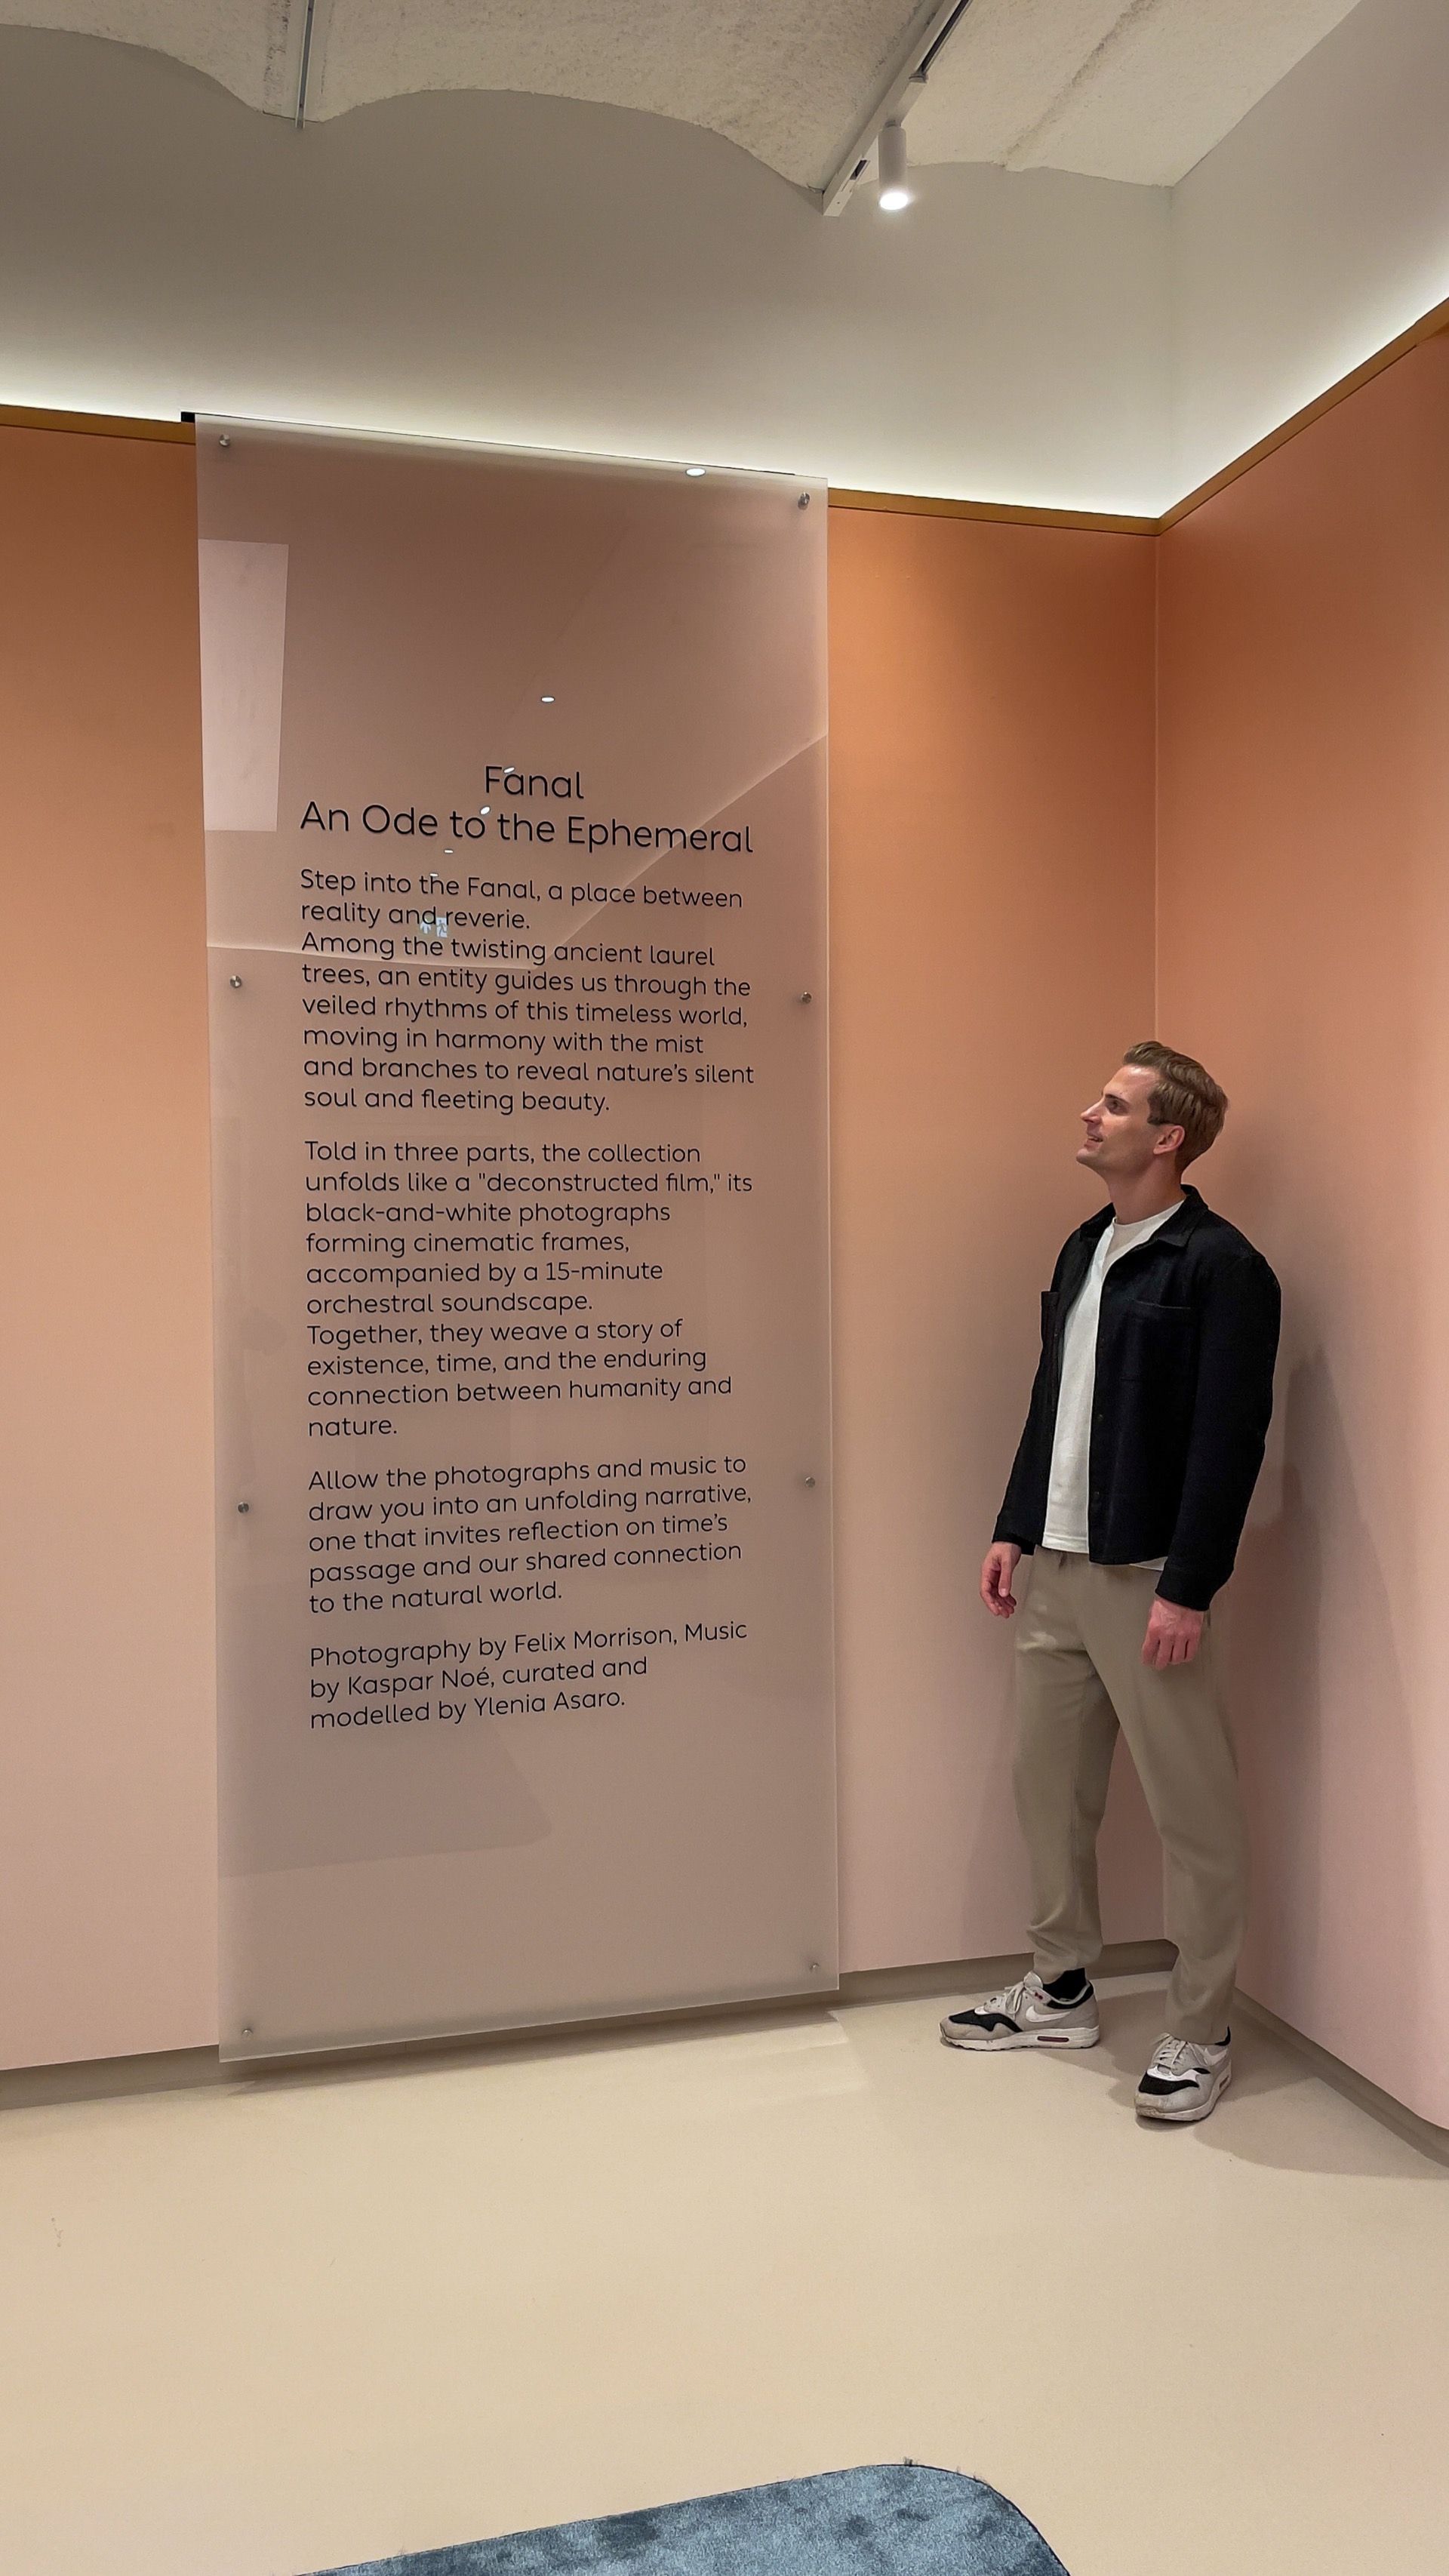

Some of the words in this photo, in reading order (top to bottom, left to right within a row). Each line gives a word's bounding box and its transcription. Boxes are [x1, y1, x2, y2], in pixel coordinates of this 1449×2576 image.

[485, 765, 585, 800] Fanal
[300, 801, 349, 833] An
[362, 804, 438, 837] Ode
[449, 808, 486, 839] to
[497, 812, 555, 843] the
[568, 816, 754, 854] Ephemeral
[300, 868, 356, 897] Step
[364, 871, 411, 894] into
[418, 872, 460, 896] the
[468, 876, 541, 902] Fanal,
[548, 885, 562, 900] a
[571, 882, 635, 907] place
[643, 885, 742, 908] between
[301, 902, 381, 929] reality
[388, 906, 437, 925] and
[445, 909, 530, 930] reverie.
[301, 931, 395, 961] Among
[401, 935, 444, 956] the
[450, 938, 546, 966] twisting
[554, 942, 643, 964] ancient
[650, 944, 715, 966] laurel
[301, 963, 370, 987] trees,
[378, 970, 410, 986] an
[418, 968, 488, 995] entity
[494, 970, 574, 996] guides
[581, 977, 608, 993] us
[614, 974, 706, 1001] through
[713, 977, 751, 996] the
[302, 994, 376, 1016] veiled
[385, 996, 488, 1023] rhythms
[494, 999, 520, 1020] of
[526, 1001, 568, 1021] this
[575, 1002, 672, 1023] timeless
[678, 1006, 747, 1028] world,
[303, 1026, 398, 1054] moving
[406, 1027, 427, 1048] in
[435, 1028, 546, 1057] harmony
[552, 1032, 603, 1051] with
[610, 1033, 648, 1053] the
[656, 1034, 704, 1054] mist
[303, 1057, 353, 1077] and
[362, 1057, 478, 1079] branches
[485, 1060, 509, 1080] to
[517, 1062, 589, 1082] reveal
[694, 1063, 755, 1084] silent
[304, 1088, 358, 1108] soul
[365, 1088, 413, 1109] and
[420, 1088, 513, 1116] fleeting
[522, 1091, 610, 1117] beauty.
[304, 1140, 356, 1161] Told
[365, 1140, 386, 1162] in
[393, 1141, 459, 1162] three
[466, 1143, 535, 1168] parts,
[541, 1143, 581, 1162] the
[587, 1143, 700, 1163] collection
[306, 1171, 400, 1192] unfolds
[408, 1171, 448, 1192] like
[455, 1177, 470, 1192] a
[478, 1172, 658, 1193] "deconstructed
[665, 1172, 720, 1195] film,"
[728, 1173, 752, 1192] its
[306, 1202, 512, 1223] black-and-white
[519, 1202, 670, 1228] photographs
[305, 1232, 405, 1259] forming
[414, 1232, 534, 1252] cinematic
[540, 1231, 629, 1253] frames,
[306, 1262, 480, 1288] accompanied
[488, 1262, 517, 1288] by
[523, 1266, 538, 1282] a
[546, 1260, 663, 1281] 15-minute
[306, 1293, 435, 1315] orchestral
[441, 1291, 592, 1316] soundscape.
[306, 1324, 423, 1351] Together,
[429, 1323, 484, 1348] they
[489, 1325, 568, 1341] weave
[574, 1325, 589, 1340] a
[597, 1321, 654, 1344] story
[660, 1318, 684, 1338] of
[307, 1355, 429, 1376] existence,
[435, 1353, 497, 1374] time,
[504, 1350, 550, 1371] and
[557, 1350, 597, 1370] the
[604, 1347, 706, 1372] enduring
[308, 1383, 448, 1406] connection
[457, 1383, 561, 1402] between
[569, 1377, 681, 1402] humanity
[688, 1375, 731, 1396] and
[309, 1417, 397, 1437] nature.
[308, 1470, 379, 1491] Allow
[386, 1467, 426, 1488] the
[435, 1460, 590, 1491] photographs
[597, 1457, 642, 1479] and
[650, 1455, 717, 1476] music
[723, 1455, 746, 1473] to
[309, 1501, 373, 1522] draw
[380, 1501, 424, 1525] you
[432, 1496, 478, 1516] into
[486, 1497, 517, 1513] an
[525, 1488, 637, 1513] unfolding
[645, 1483, 751, 1506] narrative,
[309, 1534, 356, 1552] one
[363, 1528, 417, 1550] that
[424, 1525, 500, 1547] invites
[509, 1519, 619, 1542] reflection
[626, 1520, 655, 1536] on
[309, 1562, 416, 1589] passage
[423, 1555, 470, 1577] and
[478, 1556, 519, 1574] our
[525, 1547, 606, 1571] shared
[614, 1542, 741, 1566] connection
[309, 1595, 335, 1614] to
[342, 1591, 383, 1611] the
[392, 1584, 483, 1609] natural
[489, 1580, 562, 1603] world.
[310, 1639, 472, 1669] Photography
[479, 1636, 507, 1661] by
[515, 1632, 566, 1654] Felix
[574, 1627, 678, 1650] Morrison,
[685, 1620, 748, 1642] Music
[310, 1679, 340, 1703] by
[349, 1675, 434, 1699] Kaspar
[441, 1666, 495, 1689] Noé,
[502, 1659, 594, 1685] curated
[602, 1655, 647, 1677] and
[311, 1701, 429, 1729] modelled
[438, 1700, 467, 1725] by
[473, 1693, 546, 1717] Ylenia
[553, 1691, 625, 1711] Asaro.
